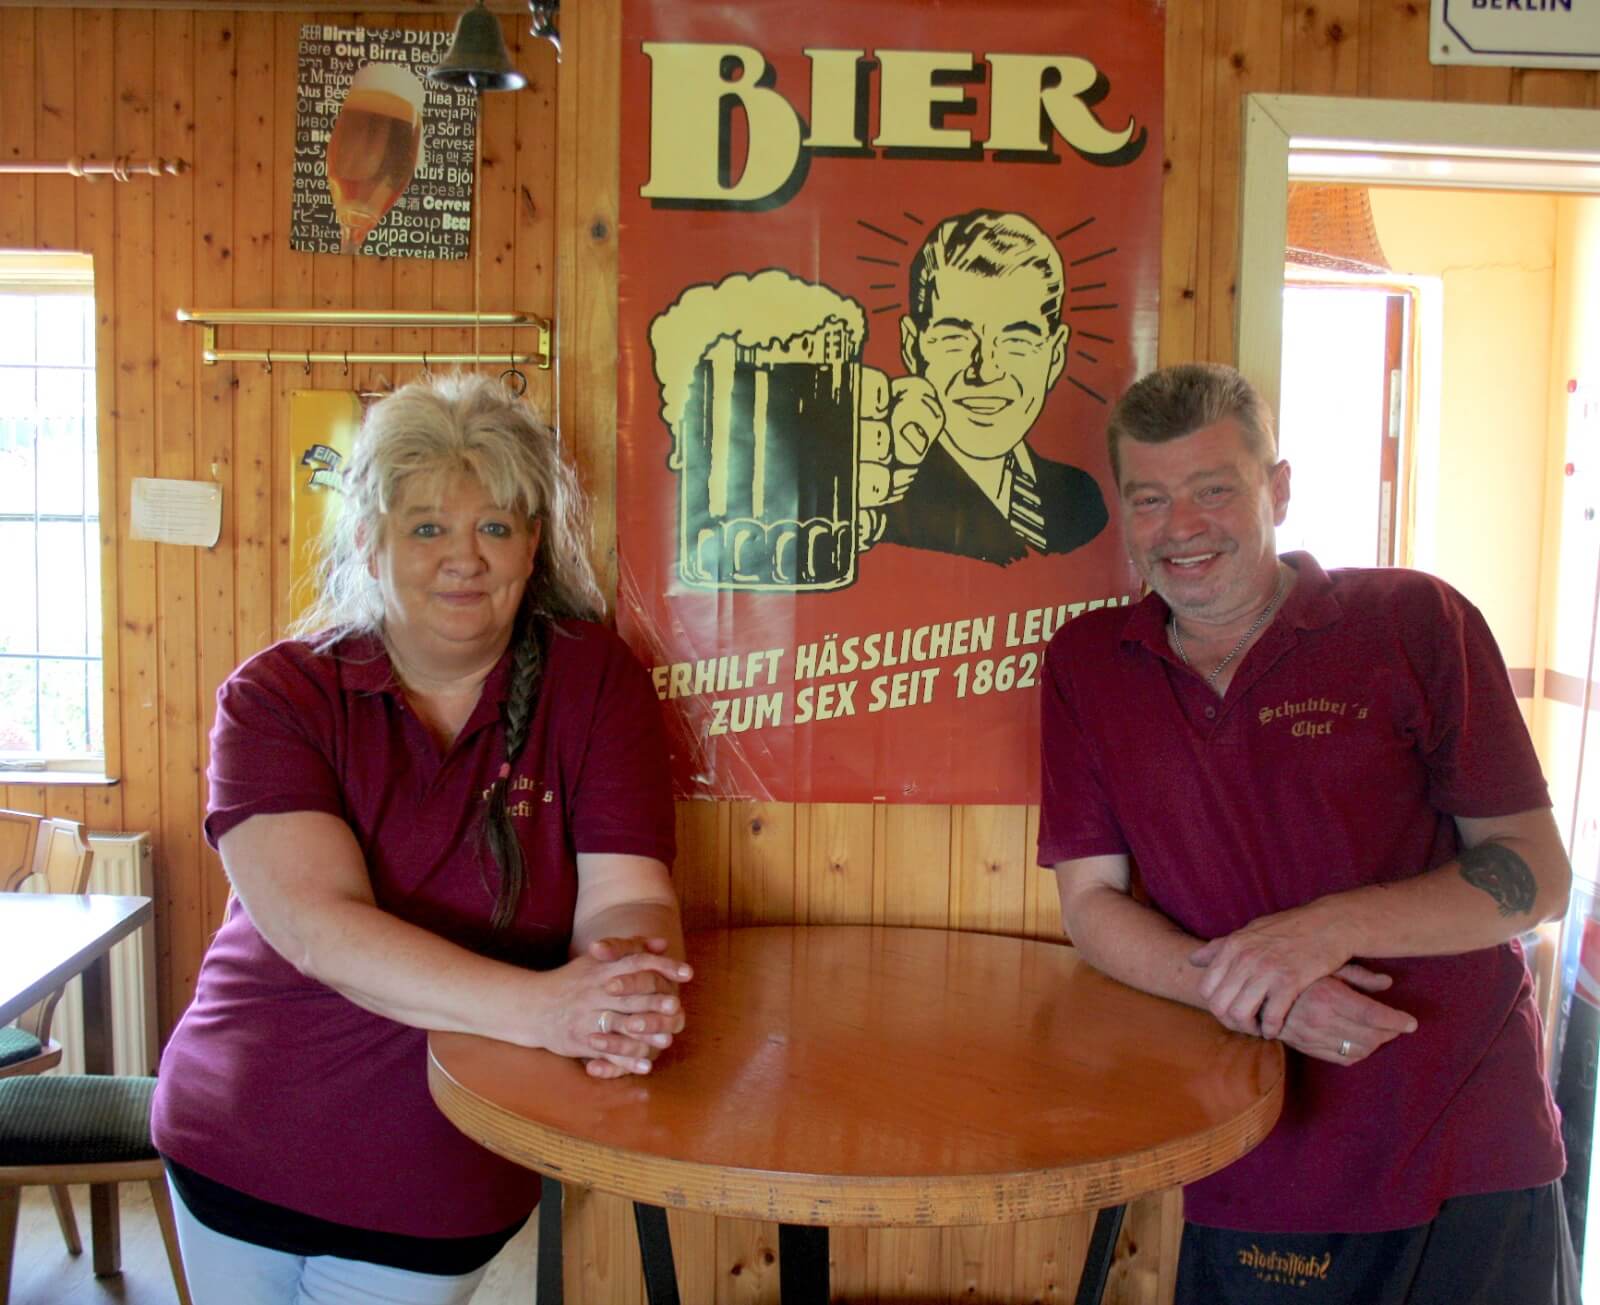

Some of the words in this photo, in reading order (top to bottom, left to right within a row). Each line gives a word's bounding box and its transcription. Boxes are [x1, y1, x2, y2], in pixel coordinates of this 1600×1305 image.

[1472, 0, 1572, 11] BERLIN
[370, 43, 407, 61] Birra
[640, 42, 1147, 213] BIER
[409, 230, 454, 246] Olut
[650, 648, 784, 700] ERHILFT
[794, 616, 996, 681] HÄSSLICHEN
[708, 692, 783, 737] ZUM
[794, 681, 858, 724] SEX
[868, 667, 940, 713] SEIT
[953, 651, 1045, 698] 1862
